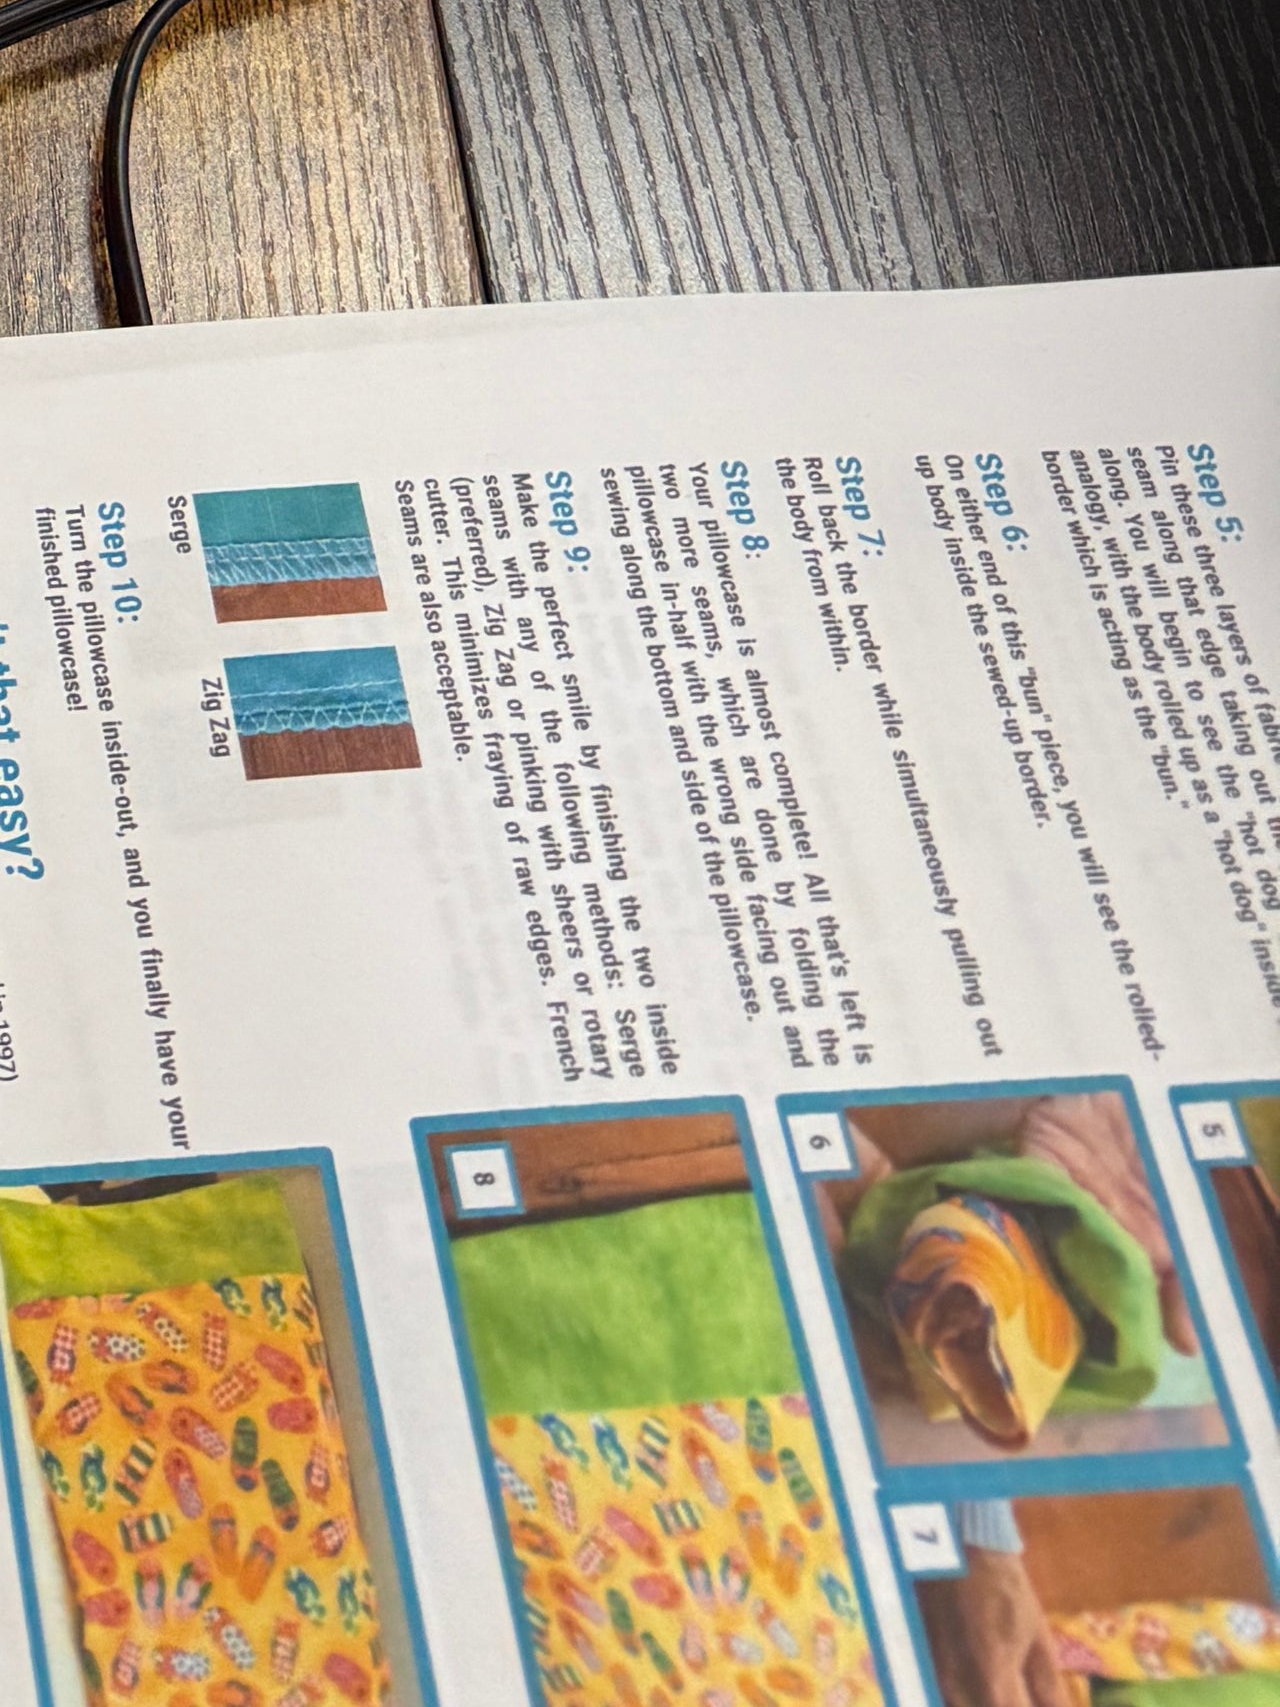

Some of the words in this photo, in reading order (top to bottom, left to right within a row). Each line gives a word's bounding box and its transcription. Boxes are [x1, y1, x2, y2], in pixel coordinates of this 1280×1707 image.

[511, 473, 539, 527] Make
[687, 461, 713, 508] Your
[720, 461, 755, 525] Step
[741, 535, 769, 558] 8:
[835, 456, 870, 521] Step
[857, 529, 885, 556] 7:
[974, 453, 1013, 516] Step
[1000, 525, 1028, 551] 6:
[1040, 450, 1074, 515] border
[1186, 443, 1226, 507] Step
[1214, 517, 1243, 542] 5:
[64, 504, 86, 551] Turn
[97, 502, 127, 568] Step
[166, 495, 191, 553] Serge
[394, 479, 422, 547] Seams
[423, 478, 450, 544] cutter.
[448, 477, 497, 592] (preferred),
[544, 471, 577, 536] Step
[563, 546, 590, 572] 9:
[34, 507, 68, 589] finished
[74, 559, 96, 592] the
[410, 553, 430, 585] are
[528, 540, 549, 572] the
[697, 519, 745, 627] pillowcase
[774, 457, 796, 489] the
[785, 494, 814, 542] body
[801, 548, 828, 596] from
[818, 602, 850, 672] within.
[1067, 521, 1102, 578] which
[111, 577, 141, 623] 10:
[441, 556, 467, 600] This
[1088, 583, 1107, 601] is
[419, 591, 442, 634] also
[482, 603, 506, 636] Zig
[533, 586, 574, 660] perfect
[1096, 607, 1131, 670] acting
[43, 595, 87, 711] pillowcase!
[75, 601, 114, 711] pillowcase
[453, 613, 493, 720] minimizes
[493, 647, 516, 687] Zag
[735, 638, 756, 657] is
[200, 677, 224, 711] Zig
[430, 640, 473, 761] acceptable.
[506, 698, 525, 720] or
[561, 673, 592, 731] smile
[744, 669, 781, 740] almost
[1121, 676, 1142, 700] as
[208, 717, 230, 757] Zag
[1133, 705, 1157, 740] the
[101, 721, 137, 837] inside-out,
[482, 732, 514, 808] fraying
[508, 732, 547, 812] pinking
[577, 744, 600, 769] by
[802, 457, 832, 495] Roll
[817, 504, 848, 552] back
[834, 561, 857, 594] the
[847, 604, 882, 673] border
[872, 682, 903, 738] while
[892, 749, 957, 916] simultaneously
[941, 928, 984, 1006] pulling
[975, 1017, 1002, 1056] out
[503, 821, 529, 844] of
[589, 784, 627, 881] finishing
[769, 751, 817, 859] complete!
[123, 848, 150, 888] and
[536, 824, 565, 871] with
[512, 857, 535, 896] raw
[802, 873, 831, 902] All
[126, 898, 153, 938] you
[550, 884, 583, 959] sheers
[618, 895, 641, 931] the
[525, 910, 555, 986] edges.
[631, 946, 655, 988] two
[140, 948, 170, 1019] finally
[572, 972, 593, 995] or
[837, 991, 865, 1031] left
[153, 1030, 177, 1086] have
[546, 1001, 583, 1082] French
[581, 1009, 613, 1079] rotary
[645, 1003, 679, 1074] inside
[852, 1044, 872, 1065] is
[159, 1096, 188, 1149] your
[808, 1135, 831, 1150] 6
[1201, 1123, 1225, 1137] 5
[472, 1172, 494, 1186] 8
[912, 1528, 937, 1545] 7
